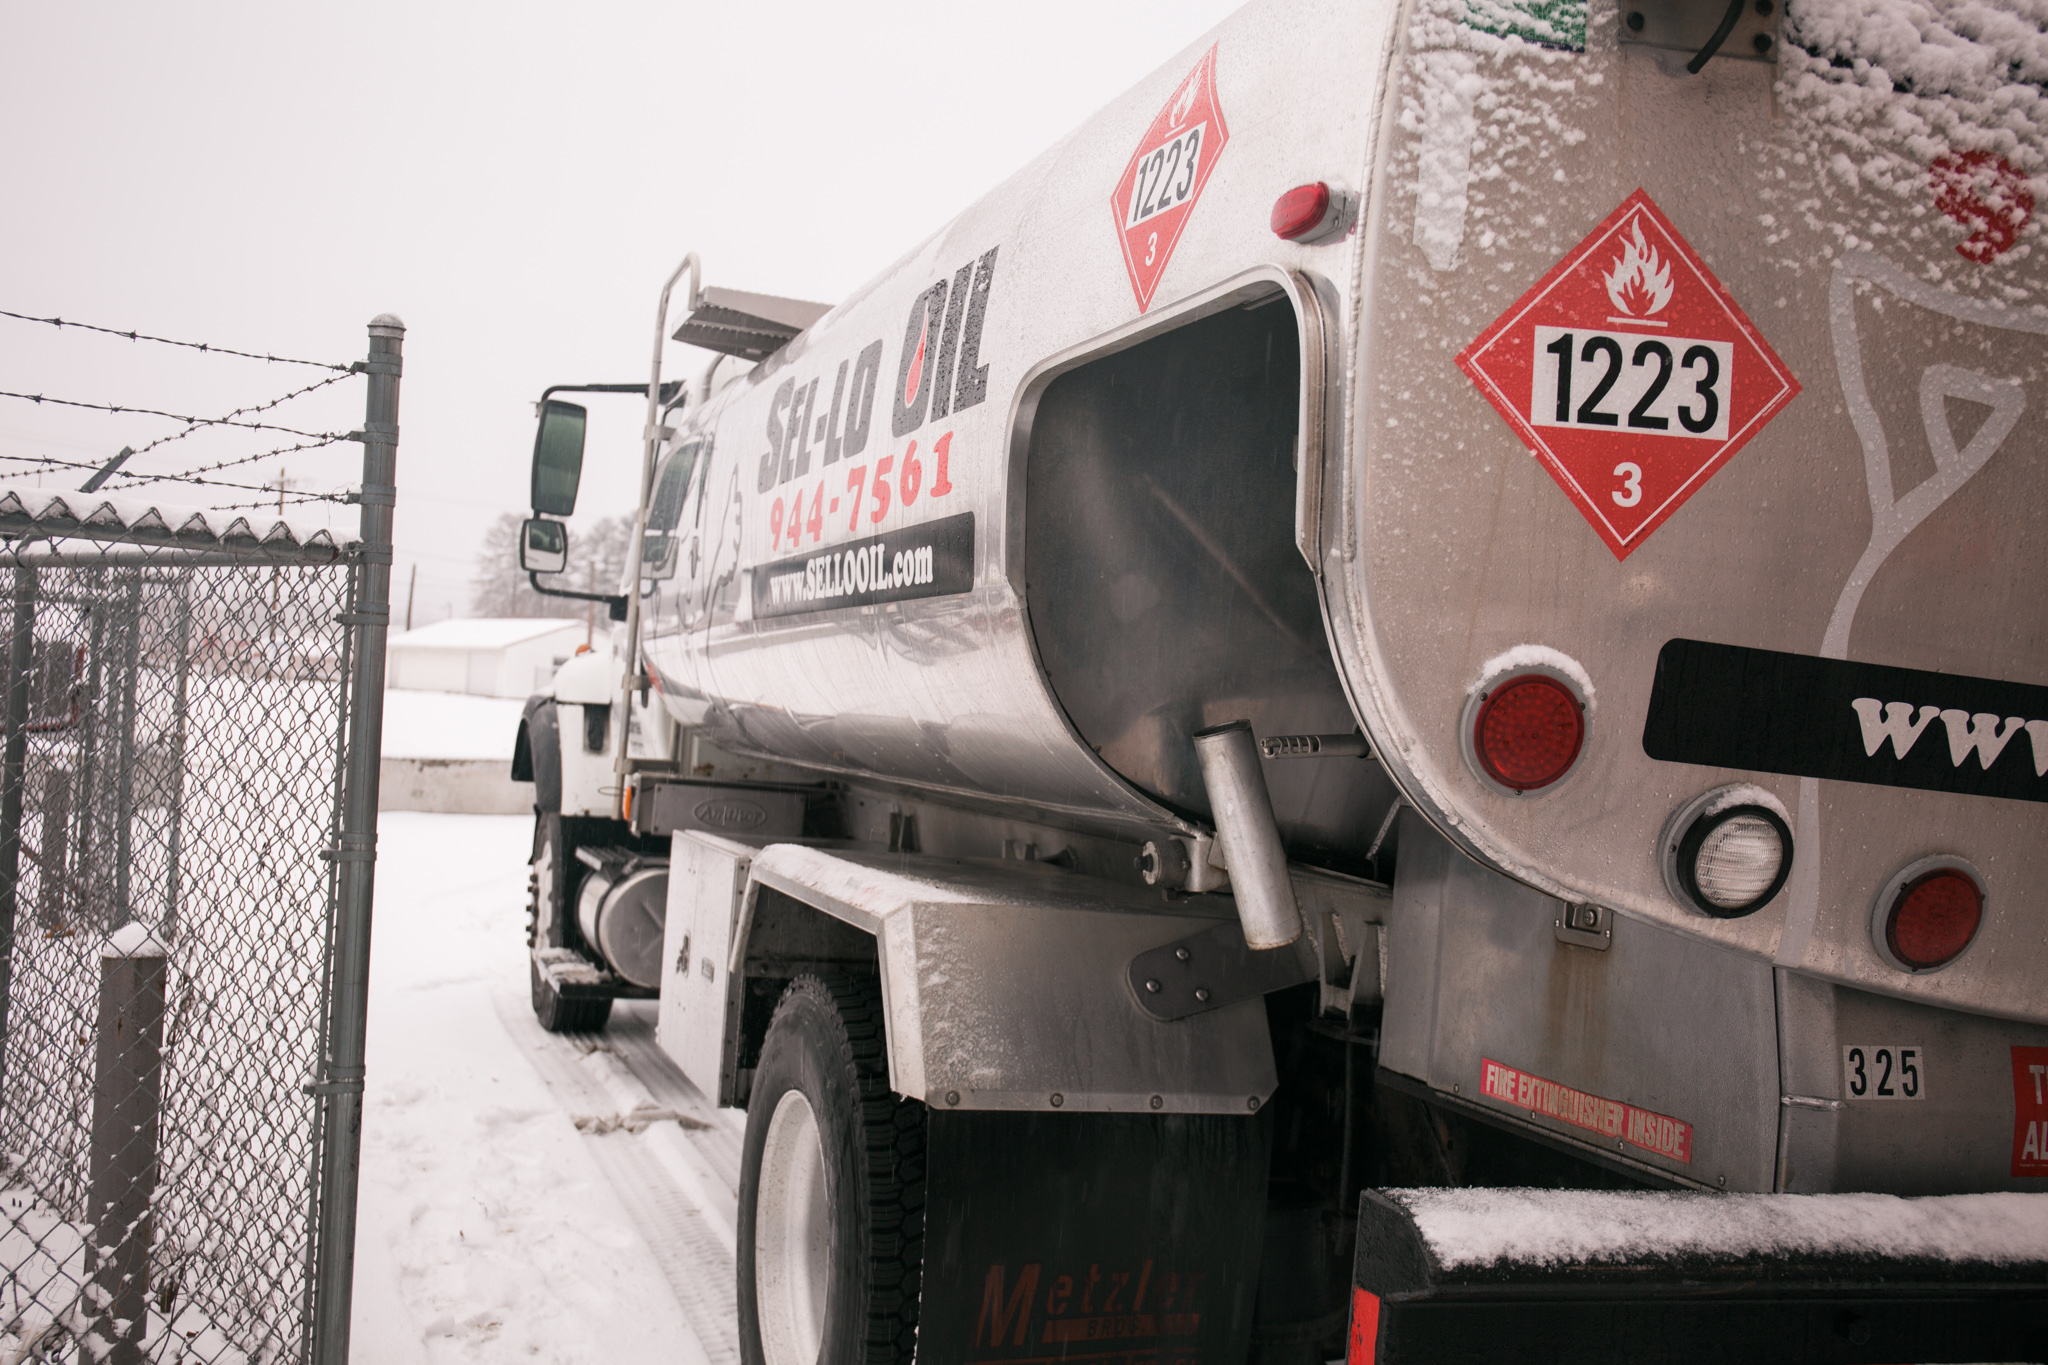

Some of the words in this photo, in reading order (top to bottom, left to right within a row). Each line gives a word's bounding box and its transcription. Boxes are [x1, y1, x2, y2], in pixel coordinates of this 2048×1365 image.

[1132, 128, 1200, 223] 1223
[1145, 232, 1158, 267] 3
[757, 338, 883, 495] SEL-LO
[891, 244, 1000, 438] OIL
[1546, 332, 1720, 434] 1223
[770, 431, 954, 552] 944-7561
[1611, 461, 1643, 507] 3
[770, 543, 934, 605] www.SELLOOIL.com
[1851, 697, 2048, 778] ww
[1486, 1064, 1516, 1100] FIRE
[1518, 1074, 1624, 1137] EXTINGUISHER
[1627, 1109, 1685, 1157] INSIDE
[1848, 1047, 1920, 1097] 325
[2029, 1064, 2048, 1105] T
